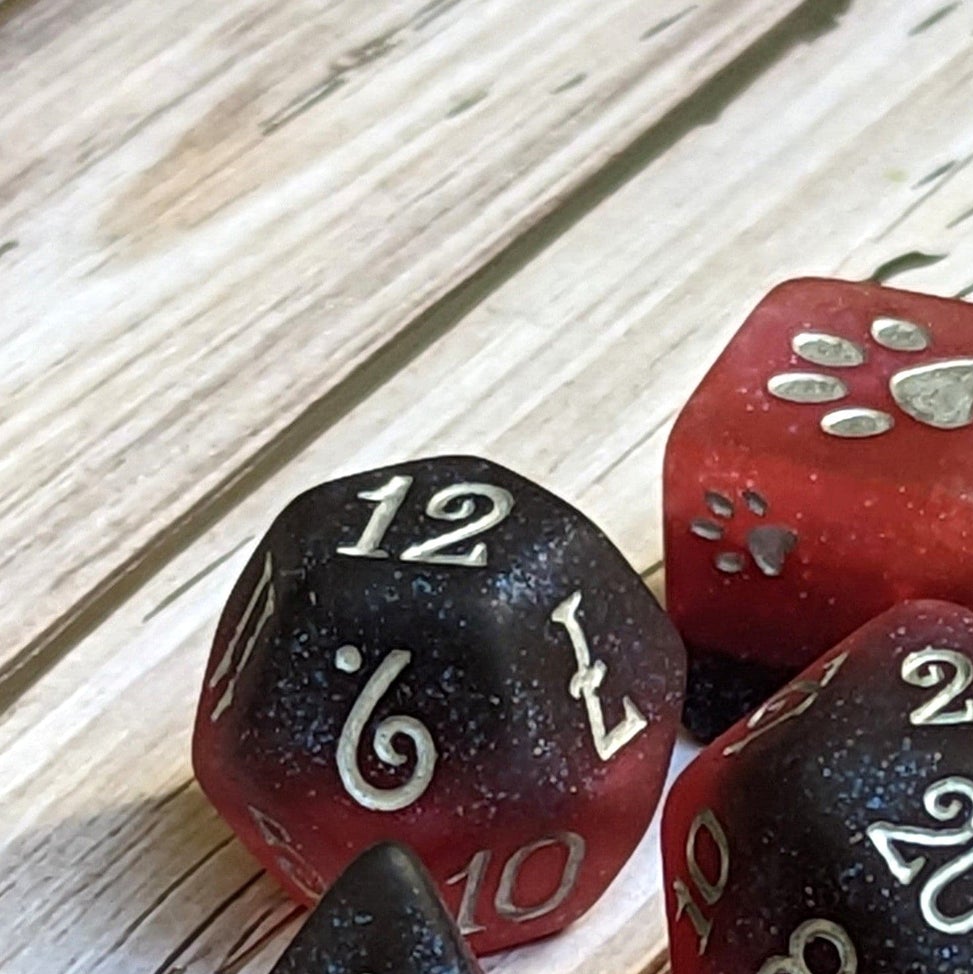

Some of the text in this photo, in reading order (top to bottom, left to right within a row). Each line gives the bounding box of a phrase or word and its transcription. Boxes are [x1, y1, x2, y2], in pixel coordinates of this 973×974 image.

[337, 475, 514, 567] 12
[445, 832, 585, 935] 10
[674, 809, 729, 954] 10
